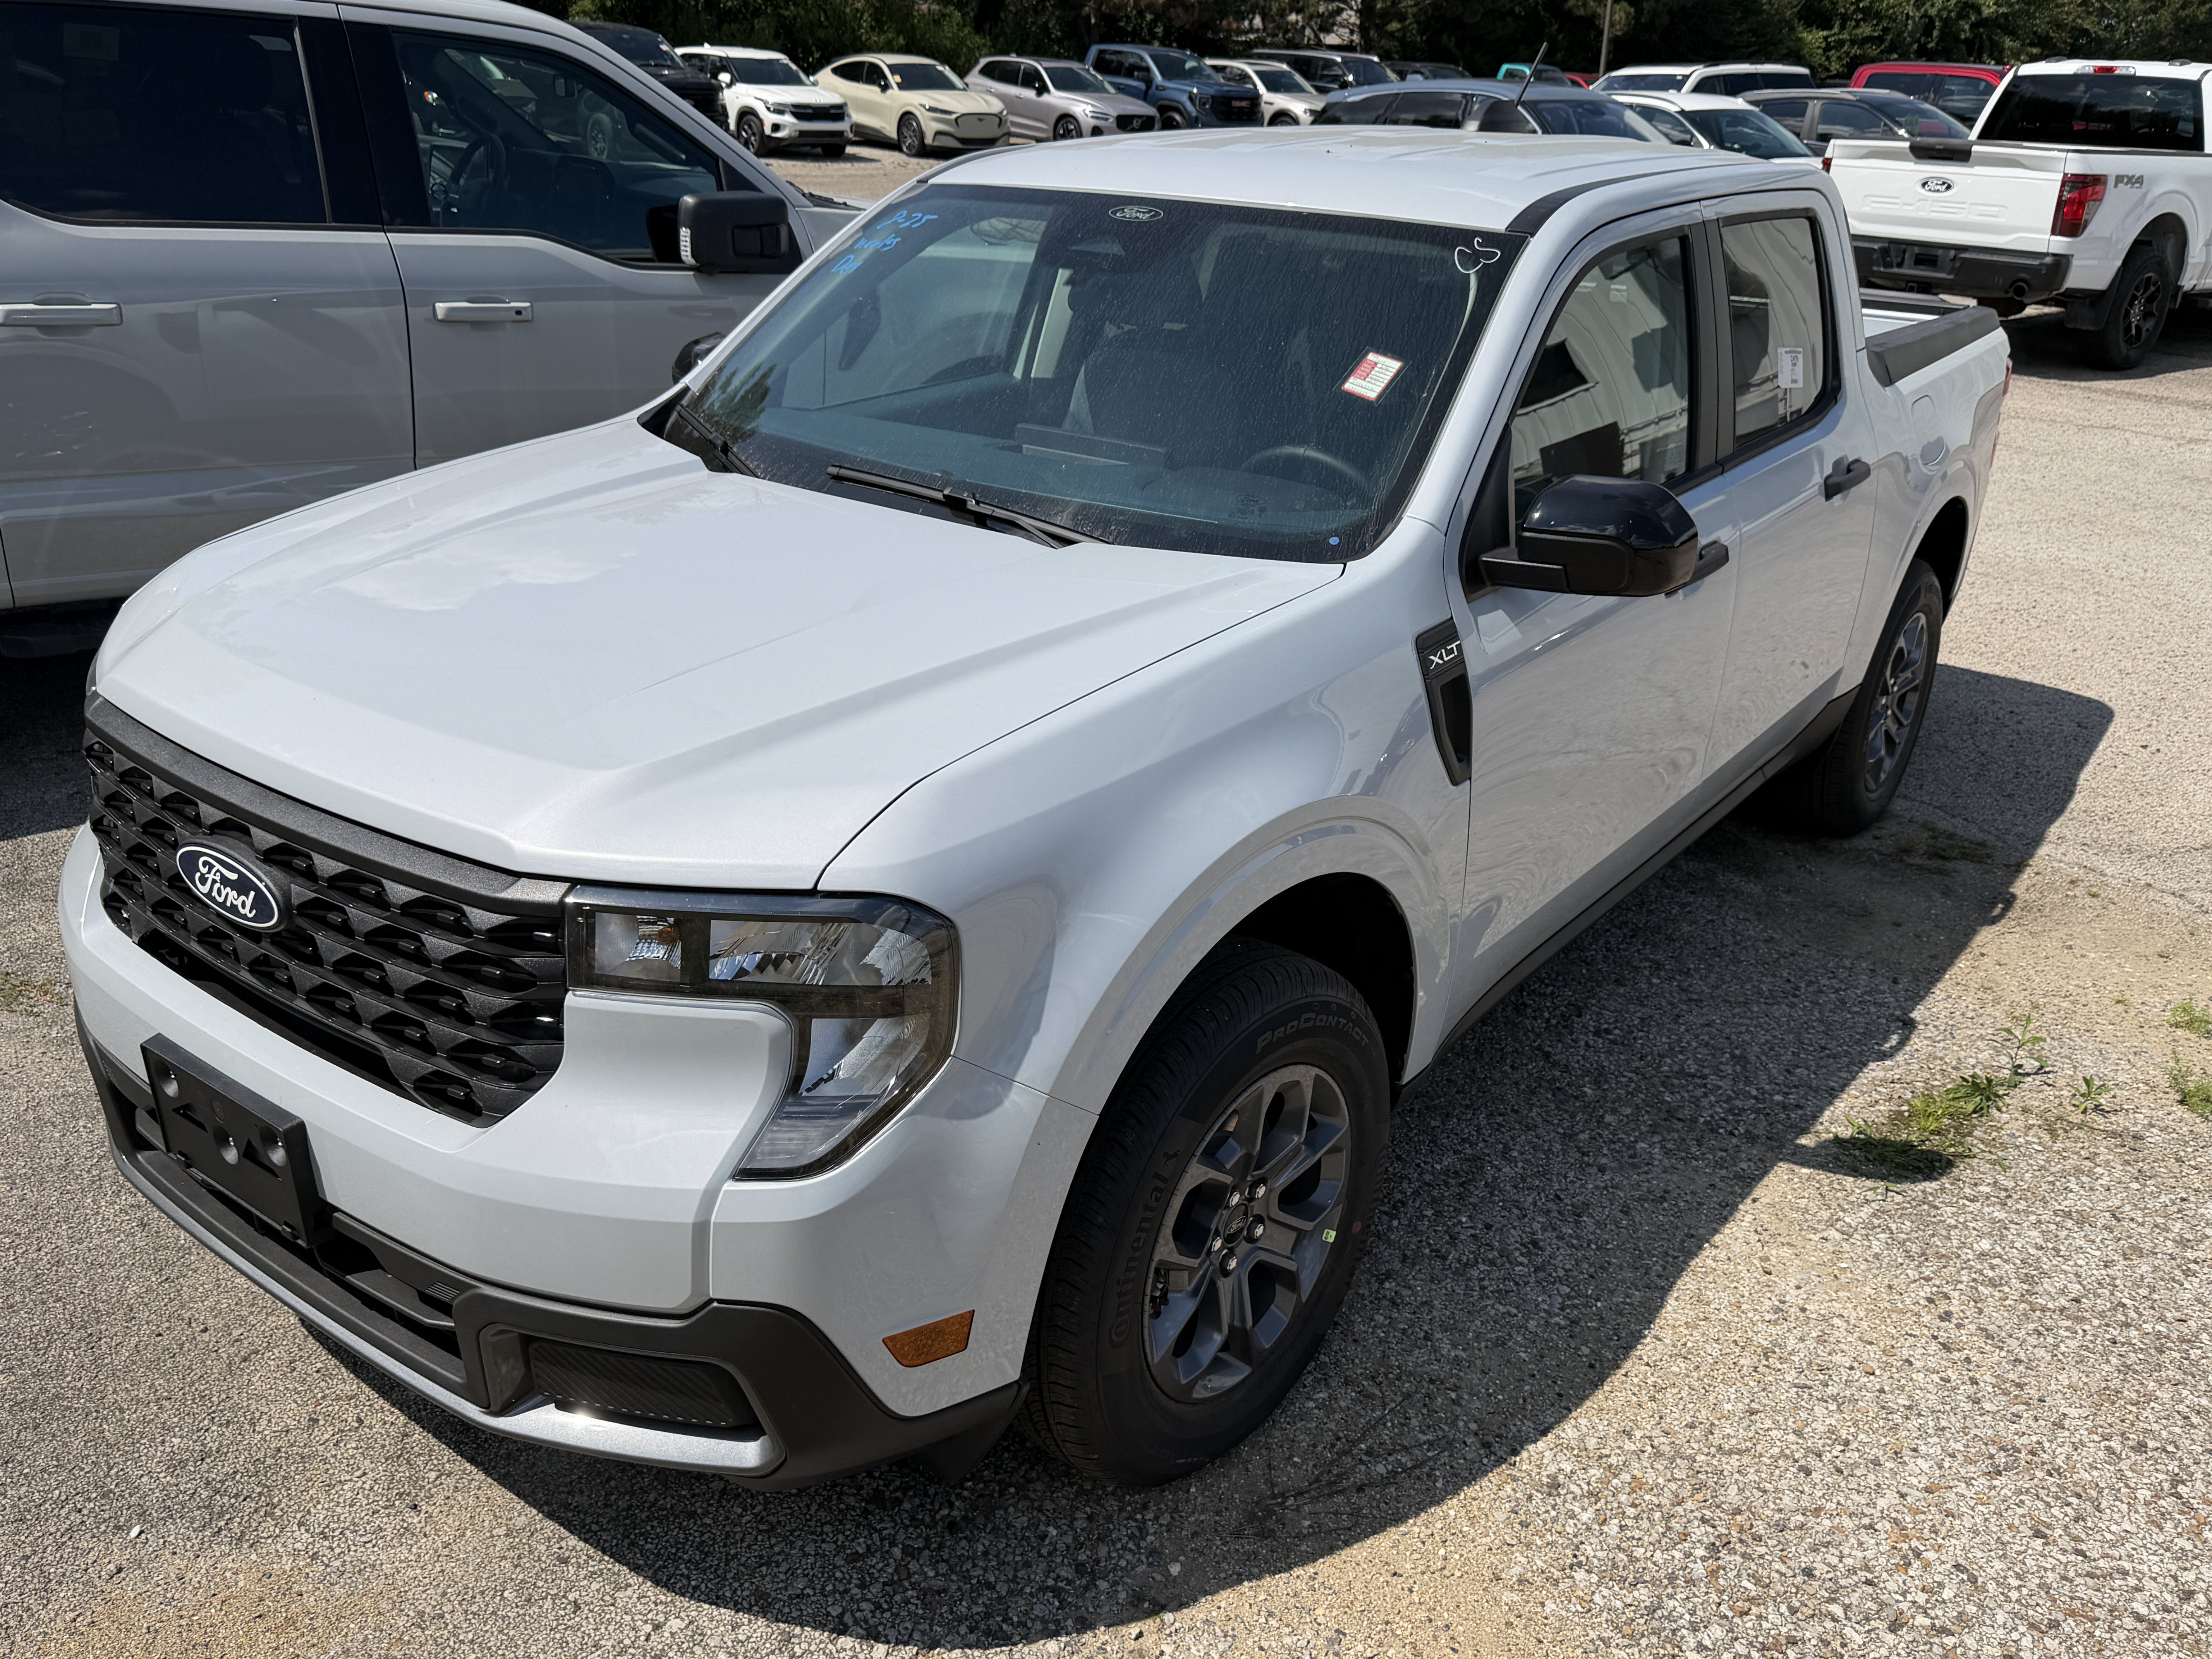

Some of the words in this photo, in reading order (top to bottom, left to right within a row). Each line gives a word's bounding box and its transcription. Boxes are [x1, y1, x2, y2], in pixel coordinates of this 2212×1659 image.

[1925, 179, 1948, 192] Ford
[2113, 174, 2144, 189] FX4
[1116, 208, 1155, 220] Ford
[1862, 194, 2009, 222] F-150
[1455, 237, 1501, 274] CS
[1428, 640, 1461, 670] XLT
[195, 856, 256, 918] Ford
[1230, 1219, 1244, 1232] Ford
[1108, 1171, 1170, 1350] Continental
